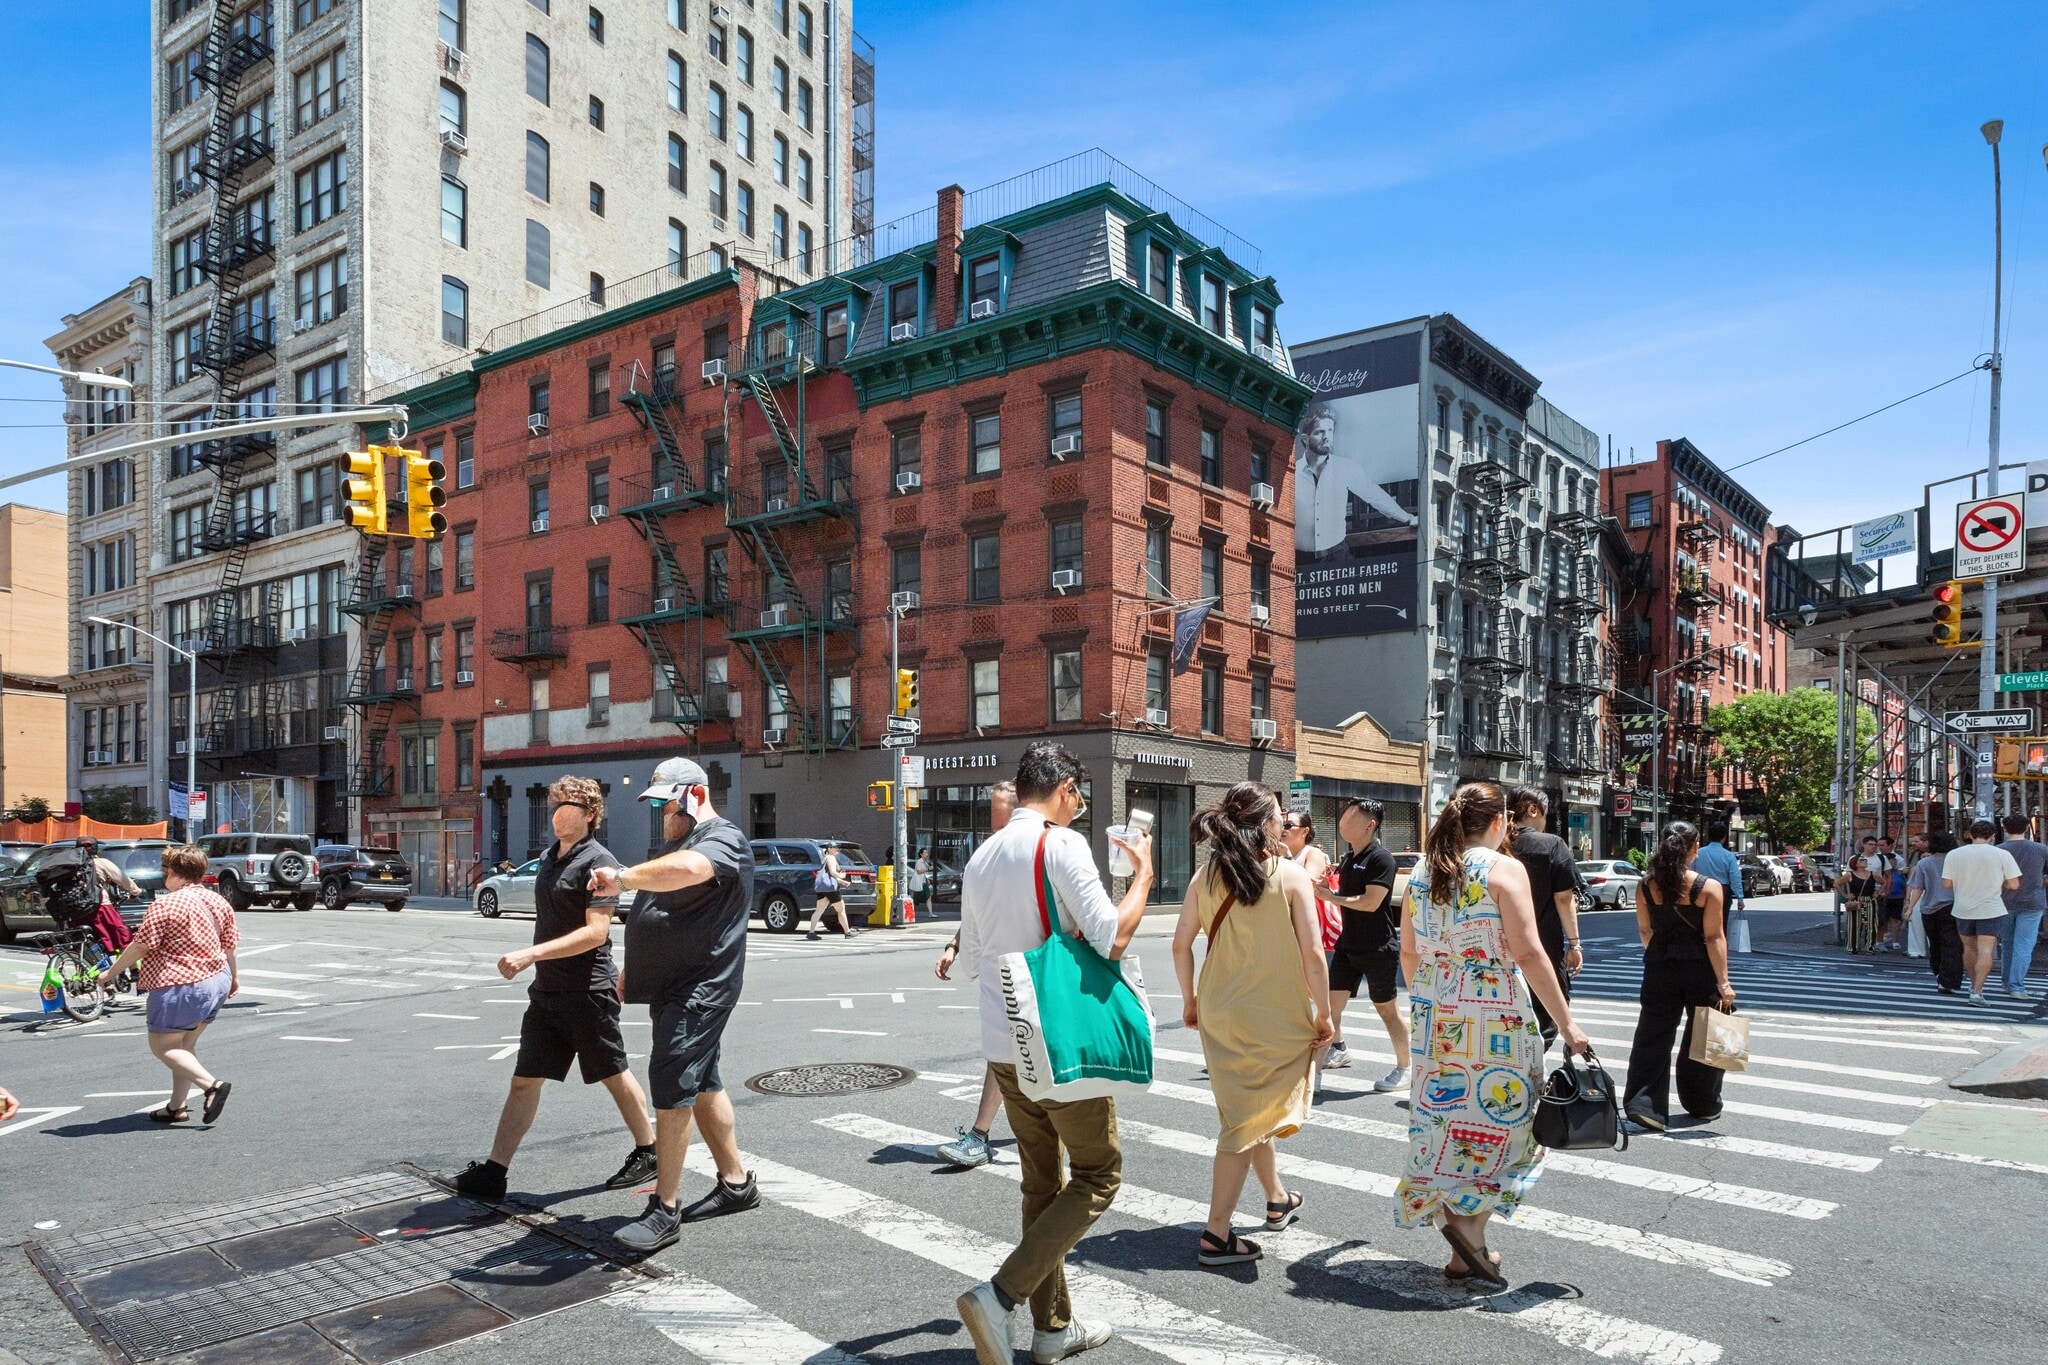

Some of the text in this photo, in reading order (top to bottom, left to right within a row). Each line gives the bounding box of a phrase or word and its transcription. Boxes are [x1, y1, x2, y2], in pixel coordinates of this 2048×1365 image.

[1860, 522, 1905, 538] SecureCom
[1960, 551, 2018, 567] EXCEPT DELIVERIES
[1310, 567, 1355, 583] STRETCH
[1360, 561, 1398, 578] FABRIC
[1968, 561, 2010, 574] THIS BLOCK
[1335, 584, 1355, 597] FOR
[1359, 581, 1382, 595] MEN
[1323, 603, 1360, 614] STREET
[1955, 715, 2024, 727] ONE WAY
[886, 737, 896, 745] ONE
[926, 755, 997, 770] AGEEST.2016
[1432, 1103, 1468, 1113] Soggiorno
